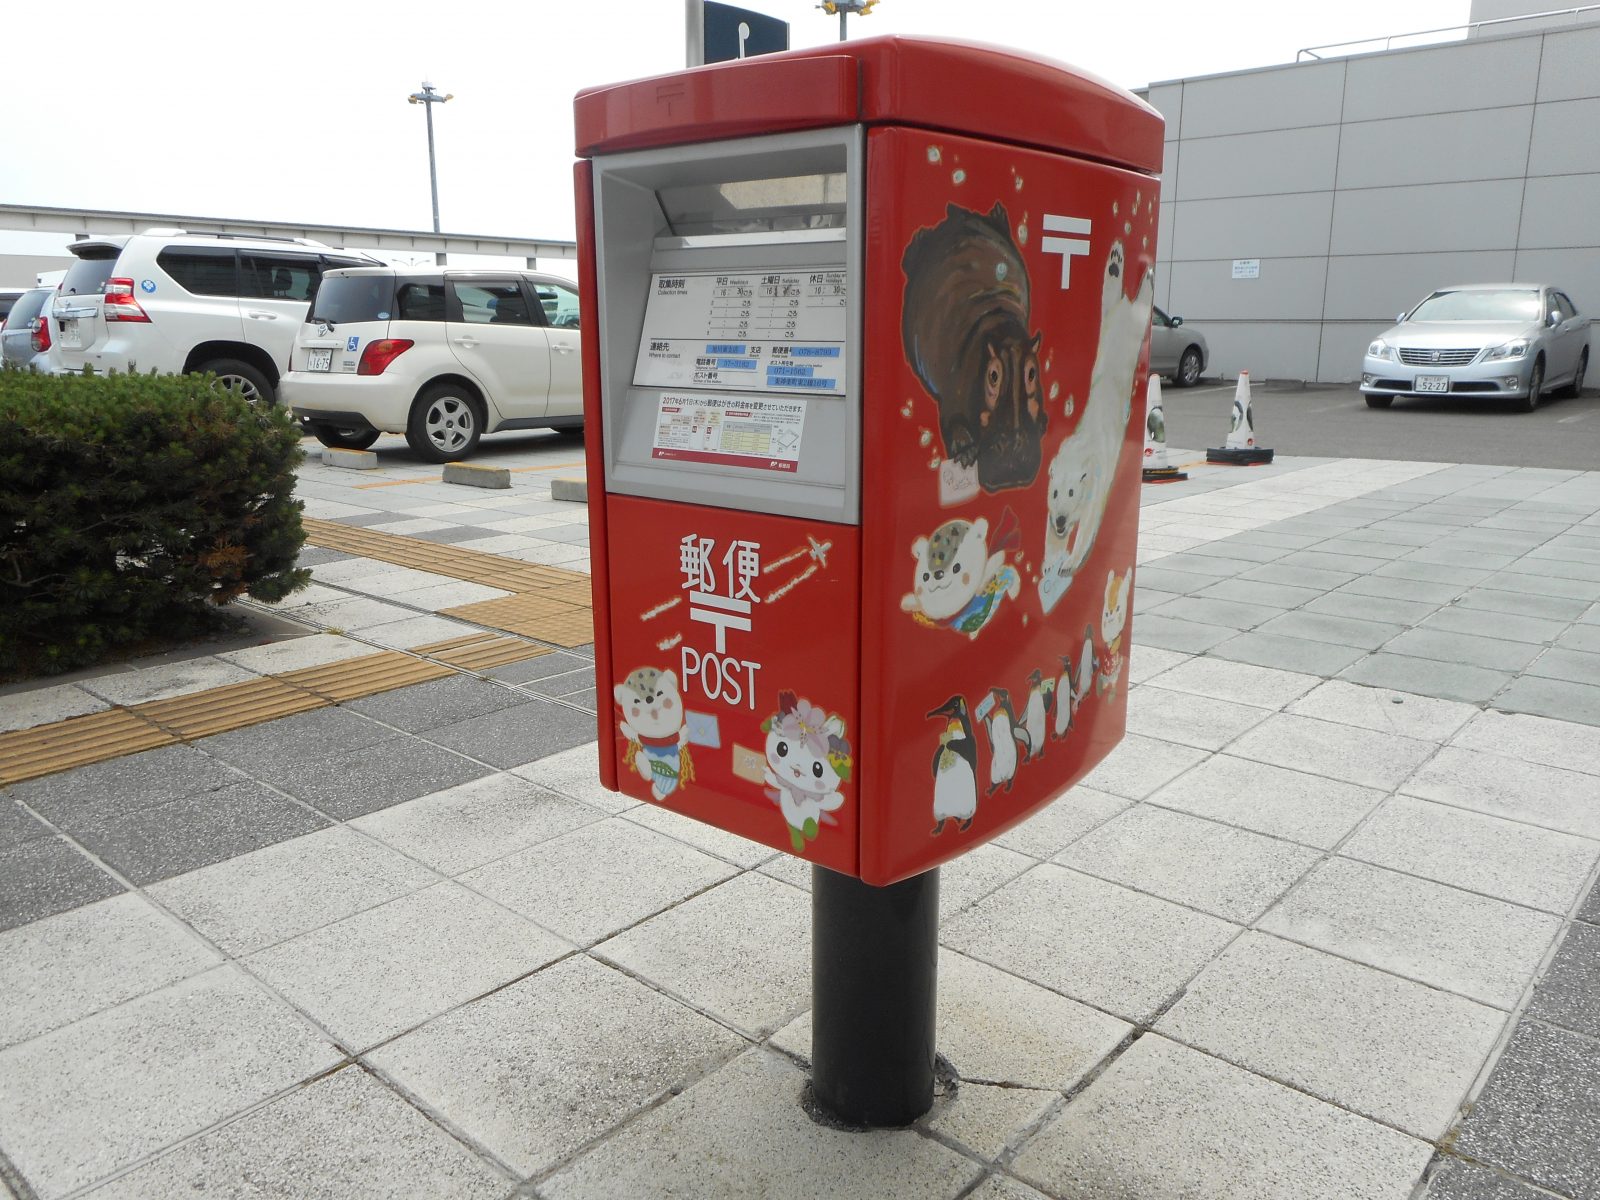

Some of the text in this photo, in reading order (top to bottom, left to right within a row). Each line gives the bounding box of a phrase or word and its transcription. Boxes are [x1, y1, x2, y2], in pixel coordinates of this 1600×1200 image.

[716, 277, 729, 286] 平日
[760, 275, 781, 285] 土曜日
[809, 274, 824, 284] 休日
[649, 342, 670, 352] 連絡先
[1422, 382, 1446, 391] 52-27
[679, 533, 761, 603] 郵便
[681, 646, 762, 710] POST
